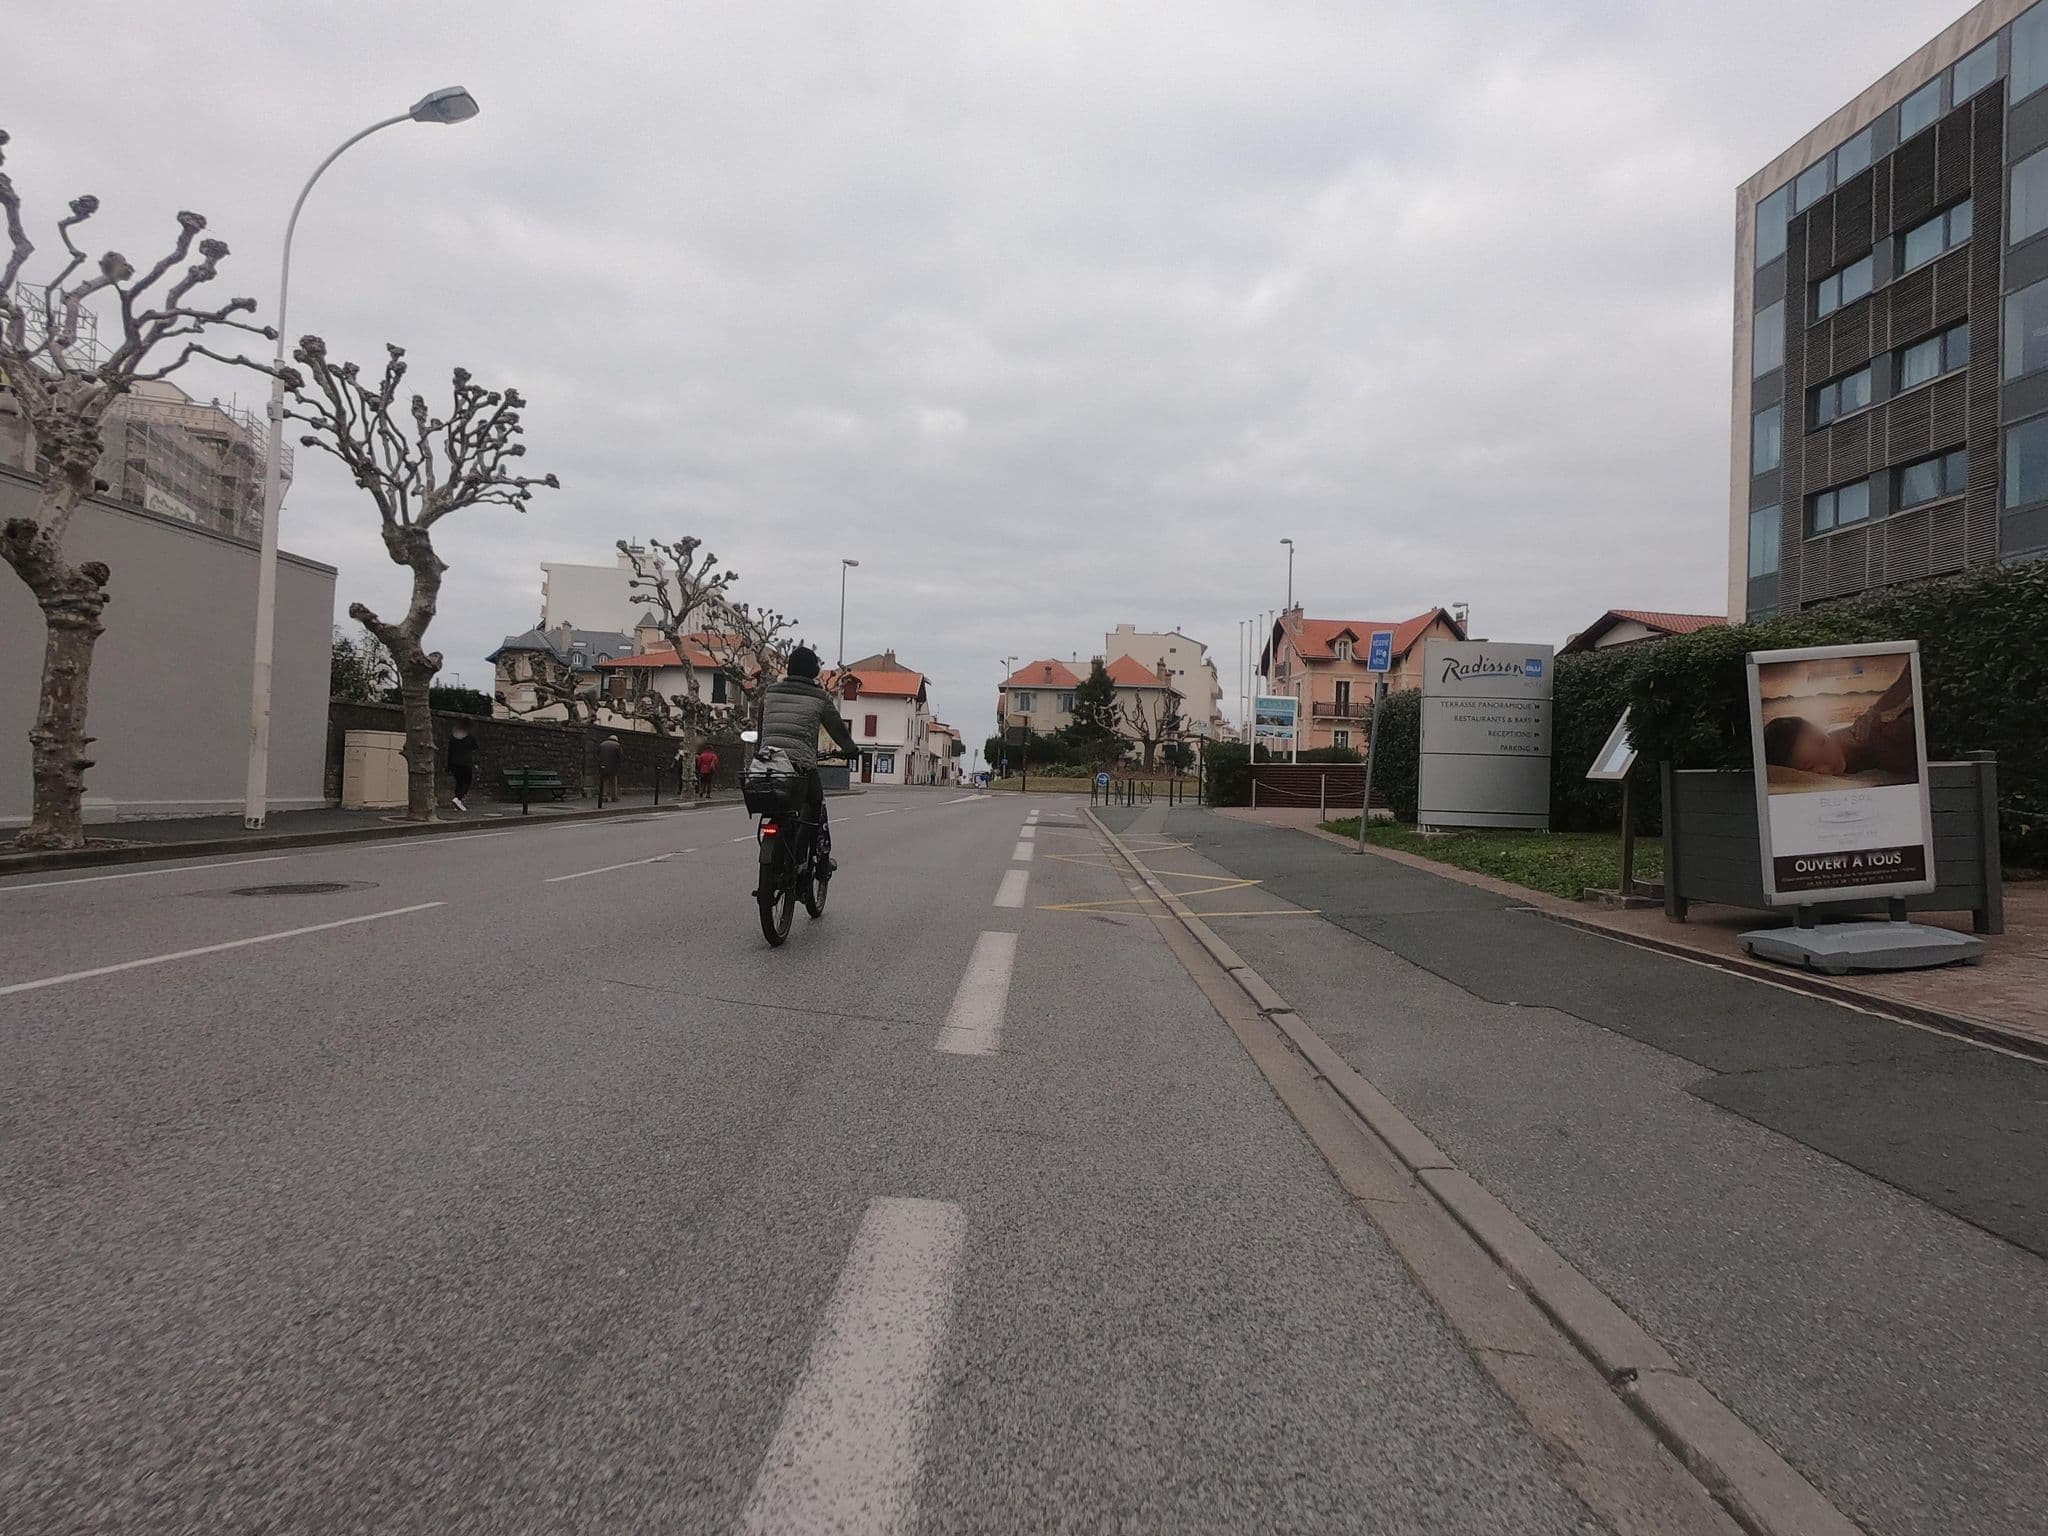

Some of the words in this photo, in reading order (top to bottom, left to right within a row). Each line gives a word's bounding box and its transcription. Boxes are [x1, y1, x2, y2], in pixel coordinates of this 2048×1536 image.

[1441, 654, 1524, 683] Radisson
[1441, 701, 1475, 709] TERRASSE
[1478, 702, 1531, 710] PANORAMIQUE
[1454, 715, 1506, 723] RESTAURANTS
[1500, 744, 1530, 752] PARKING
[1795, 855, 1848, 872] OUVERT
[1867, 852, 1902, 866] TOUS
